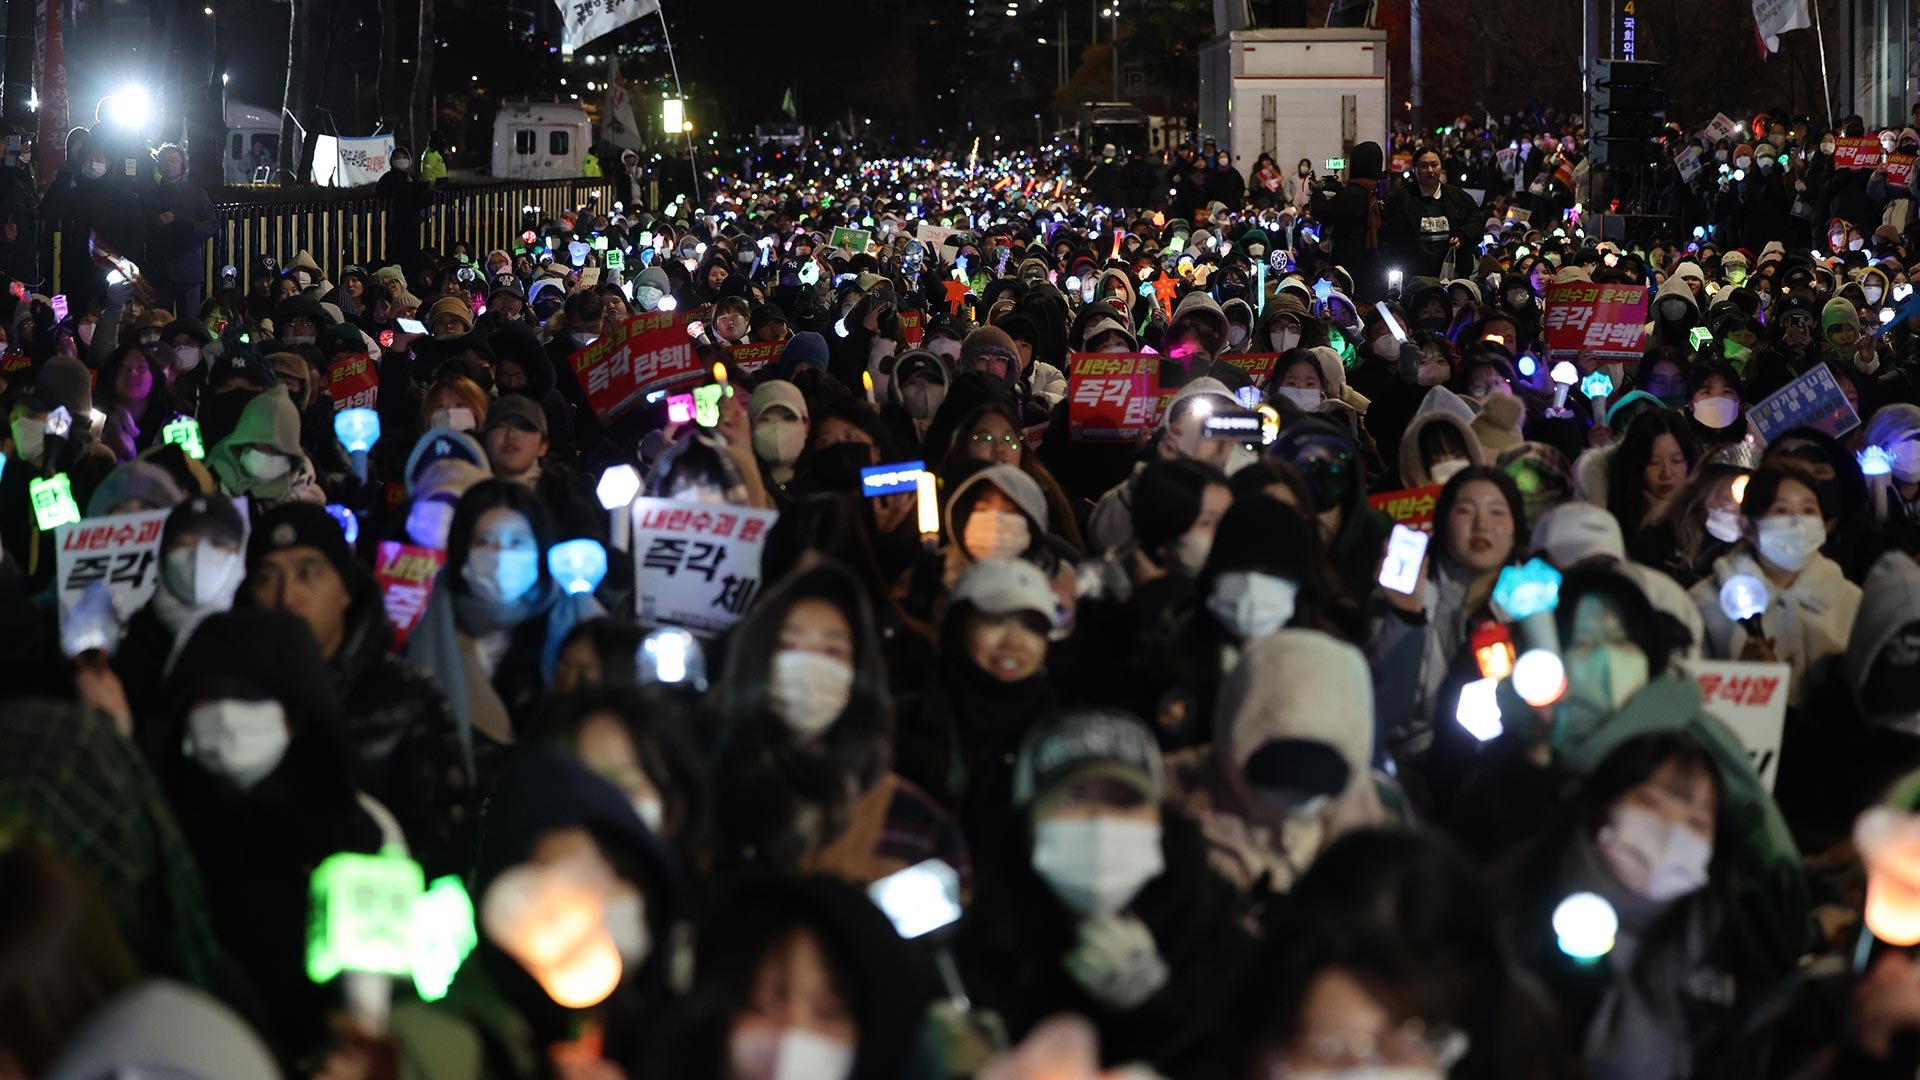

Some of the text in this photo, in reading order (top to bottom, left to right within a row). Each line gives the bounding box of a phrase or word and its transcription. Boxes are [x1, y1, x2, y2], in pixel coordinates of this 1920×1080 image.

[1624, 0, 1635, 15] 4
[607, 252, 620, 266] 탄
[1600, 288, 1643, 305] 윤석열
[631, 313, 674, 337] 윤석열
[1545, 306, 1594, 331] 즉각
[1583, 322, 1645, 348] 탄핵!
[333, 358, 368, 383] 윤석열
[587, 344, 632, 395] 즉각
[633, 343, 692, 385] 탄핵!
[1074, 359, 1136, 376] 내란수괴
[1073, 379, 1133, 408] 즉각
[63, 519, 162, 551] 내란수괴
[640, 510, 738, 537] 내란수괴
[643, 538, 727, 583] 즉각
[711, 574, 756, 614] 체
